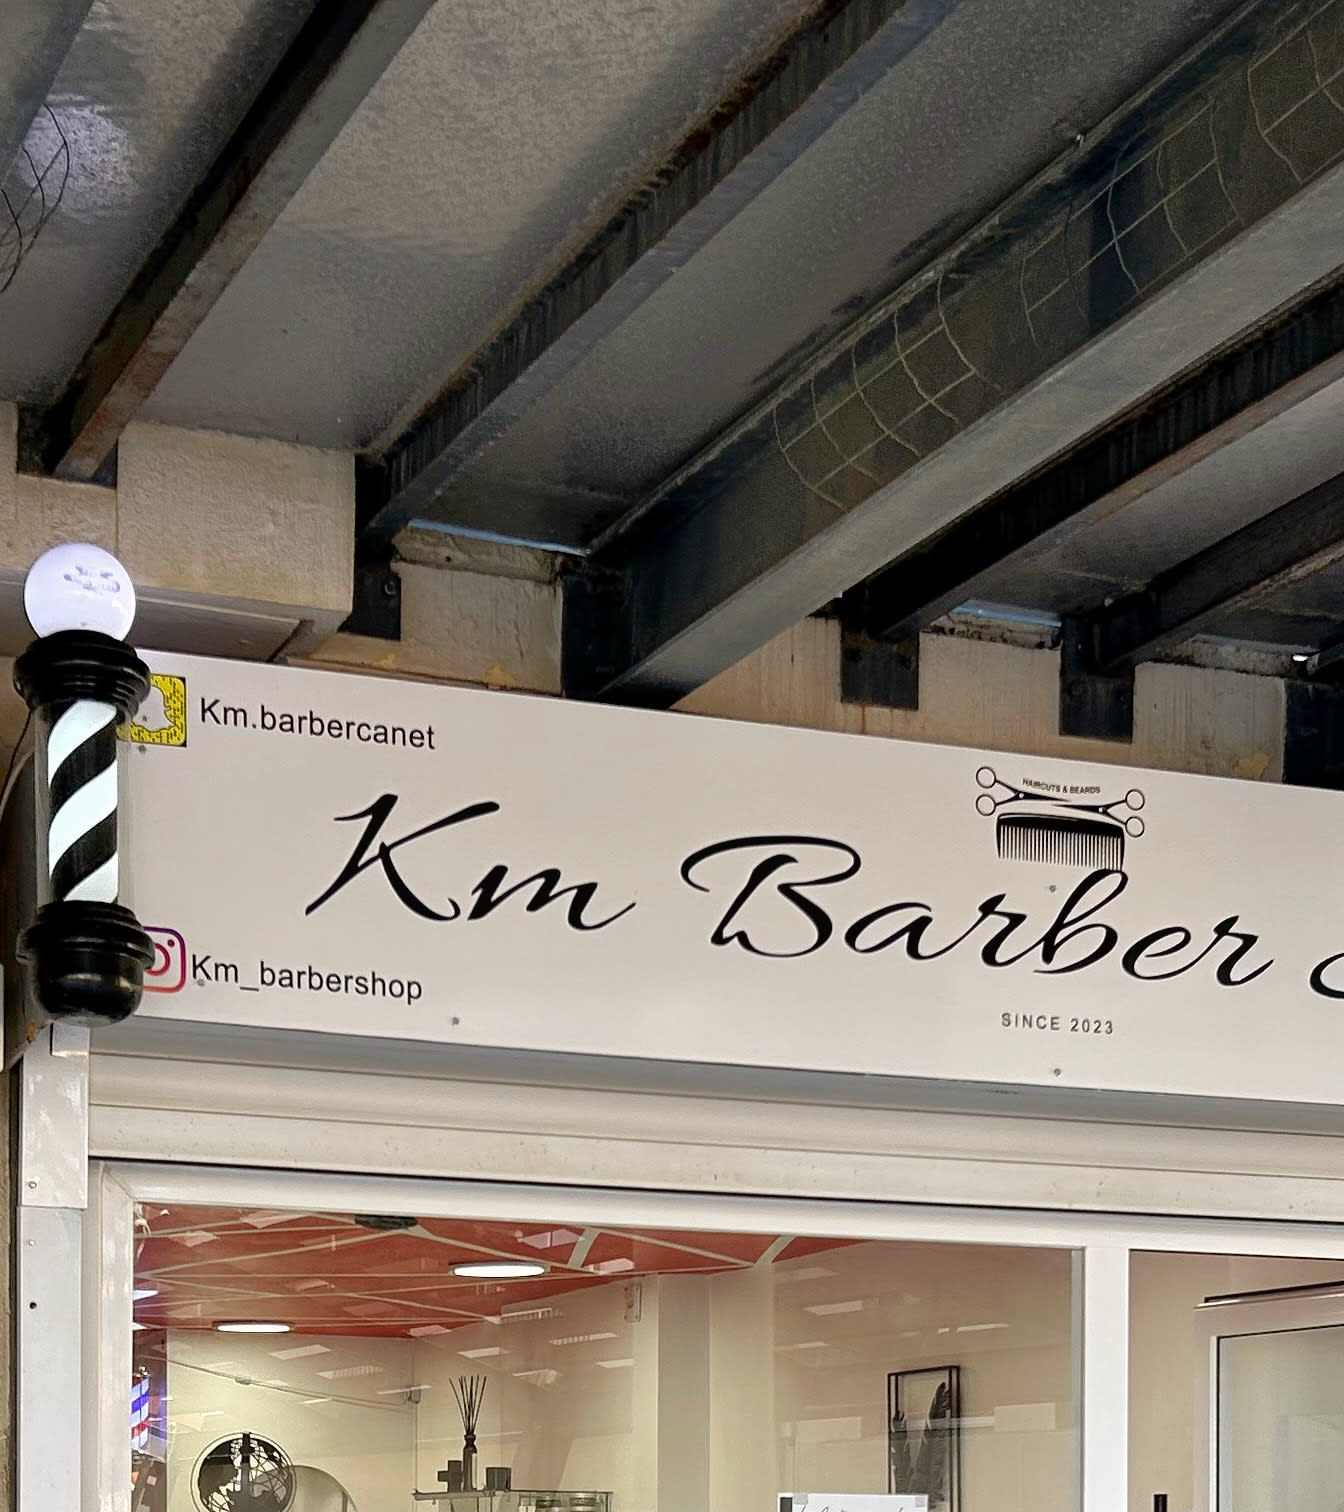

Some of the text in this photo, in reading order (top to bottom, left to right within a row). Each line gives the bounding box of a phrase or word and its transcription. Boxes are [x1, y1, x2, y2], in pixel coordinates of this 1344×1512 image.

[199, 697, 436, 750] Km.barbercanet
[305, 793, 637, 931] Km
[680, 834, 1276, 987] Barber
[191, 953, 423, 1005] Km_barbershop
[1001, 1012, 1113, 1035] SINCE 2023
